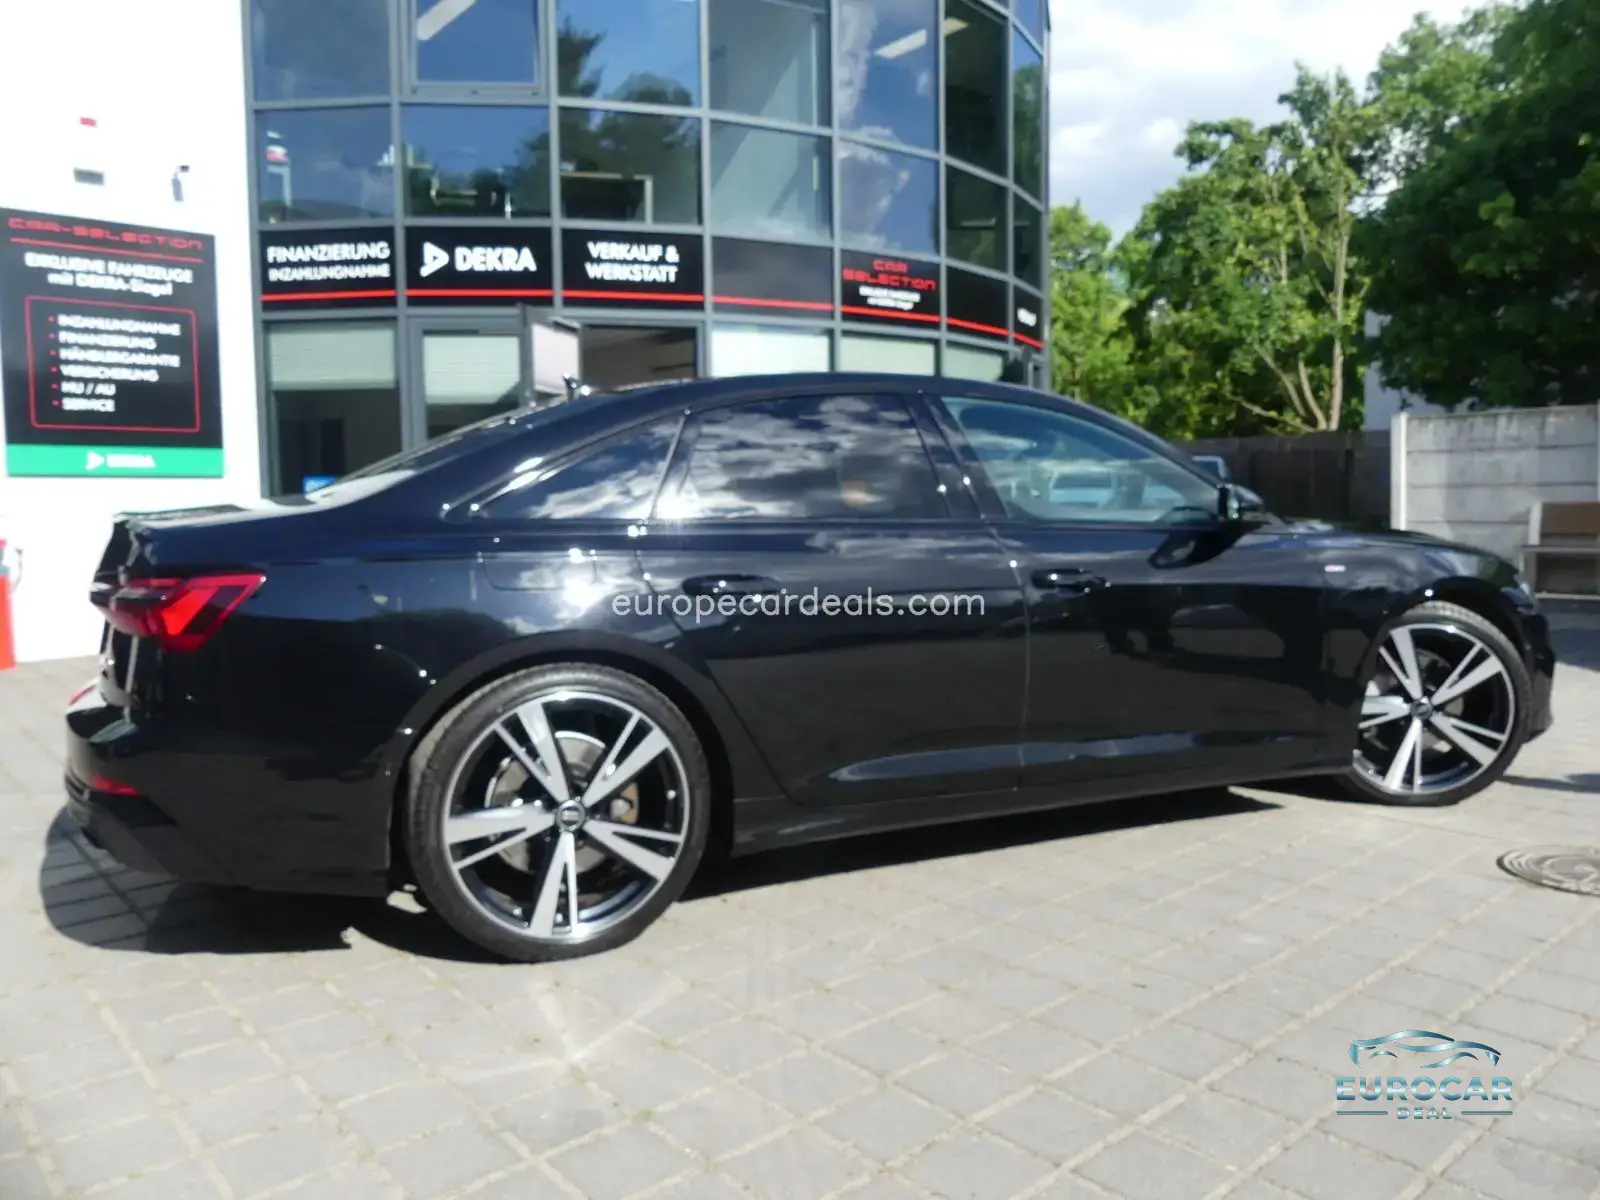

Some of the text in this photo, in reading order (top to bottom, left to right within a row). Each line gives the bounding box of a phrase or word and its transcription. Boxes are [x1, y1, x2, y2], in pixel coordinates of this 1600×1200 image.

[266, 241, 391, 263] FINANZIERUNG
[454, 247, 537, 271] DEKRA
[587, 241, 680, 263] VERKAUF &
[268, 263, 391, 282] INZAHLUNGNAHME
[584, 262, 678, 283] WERKSTATT
